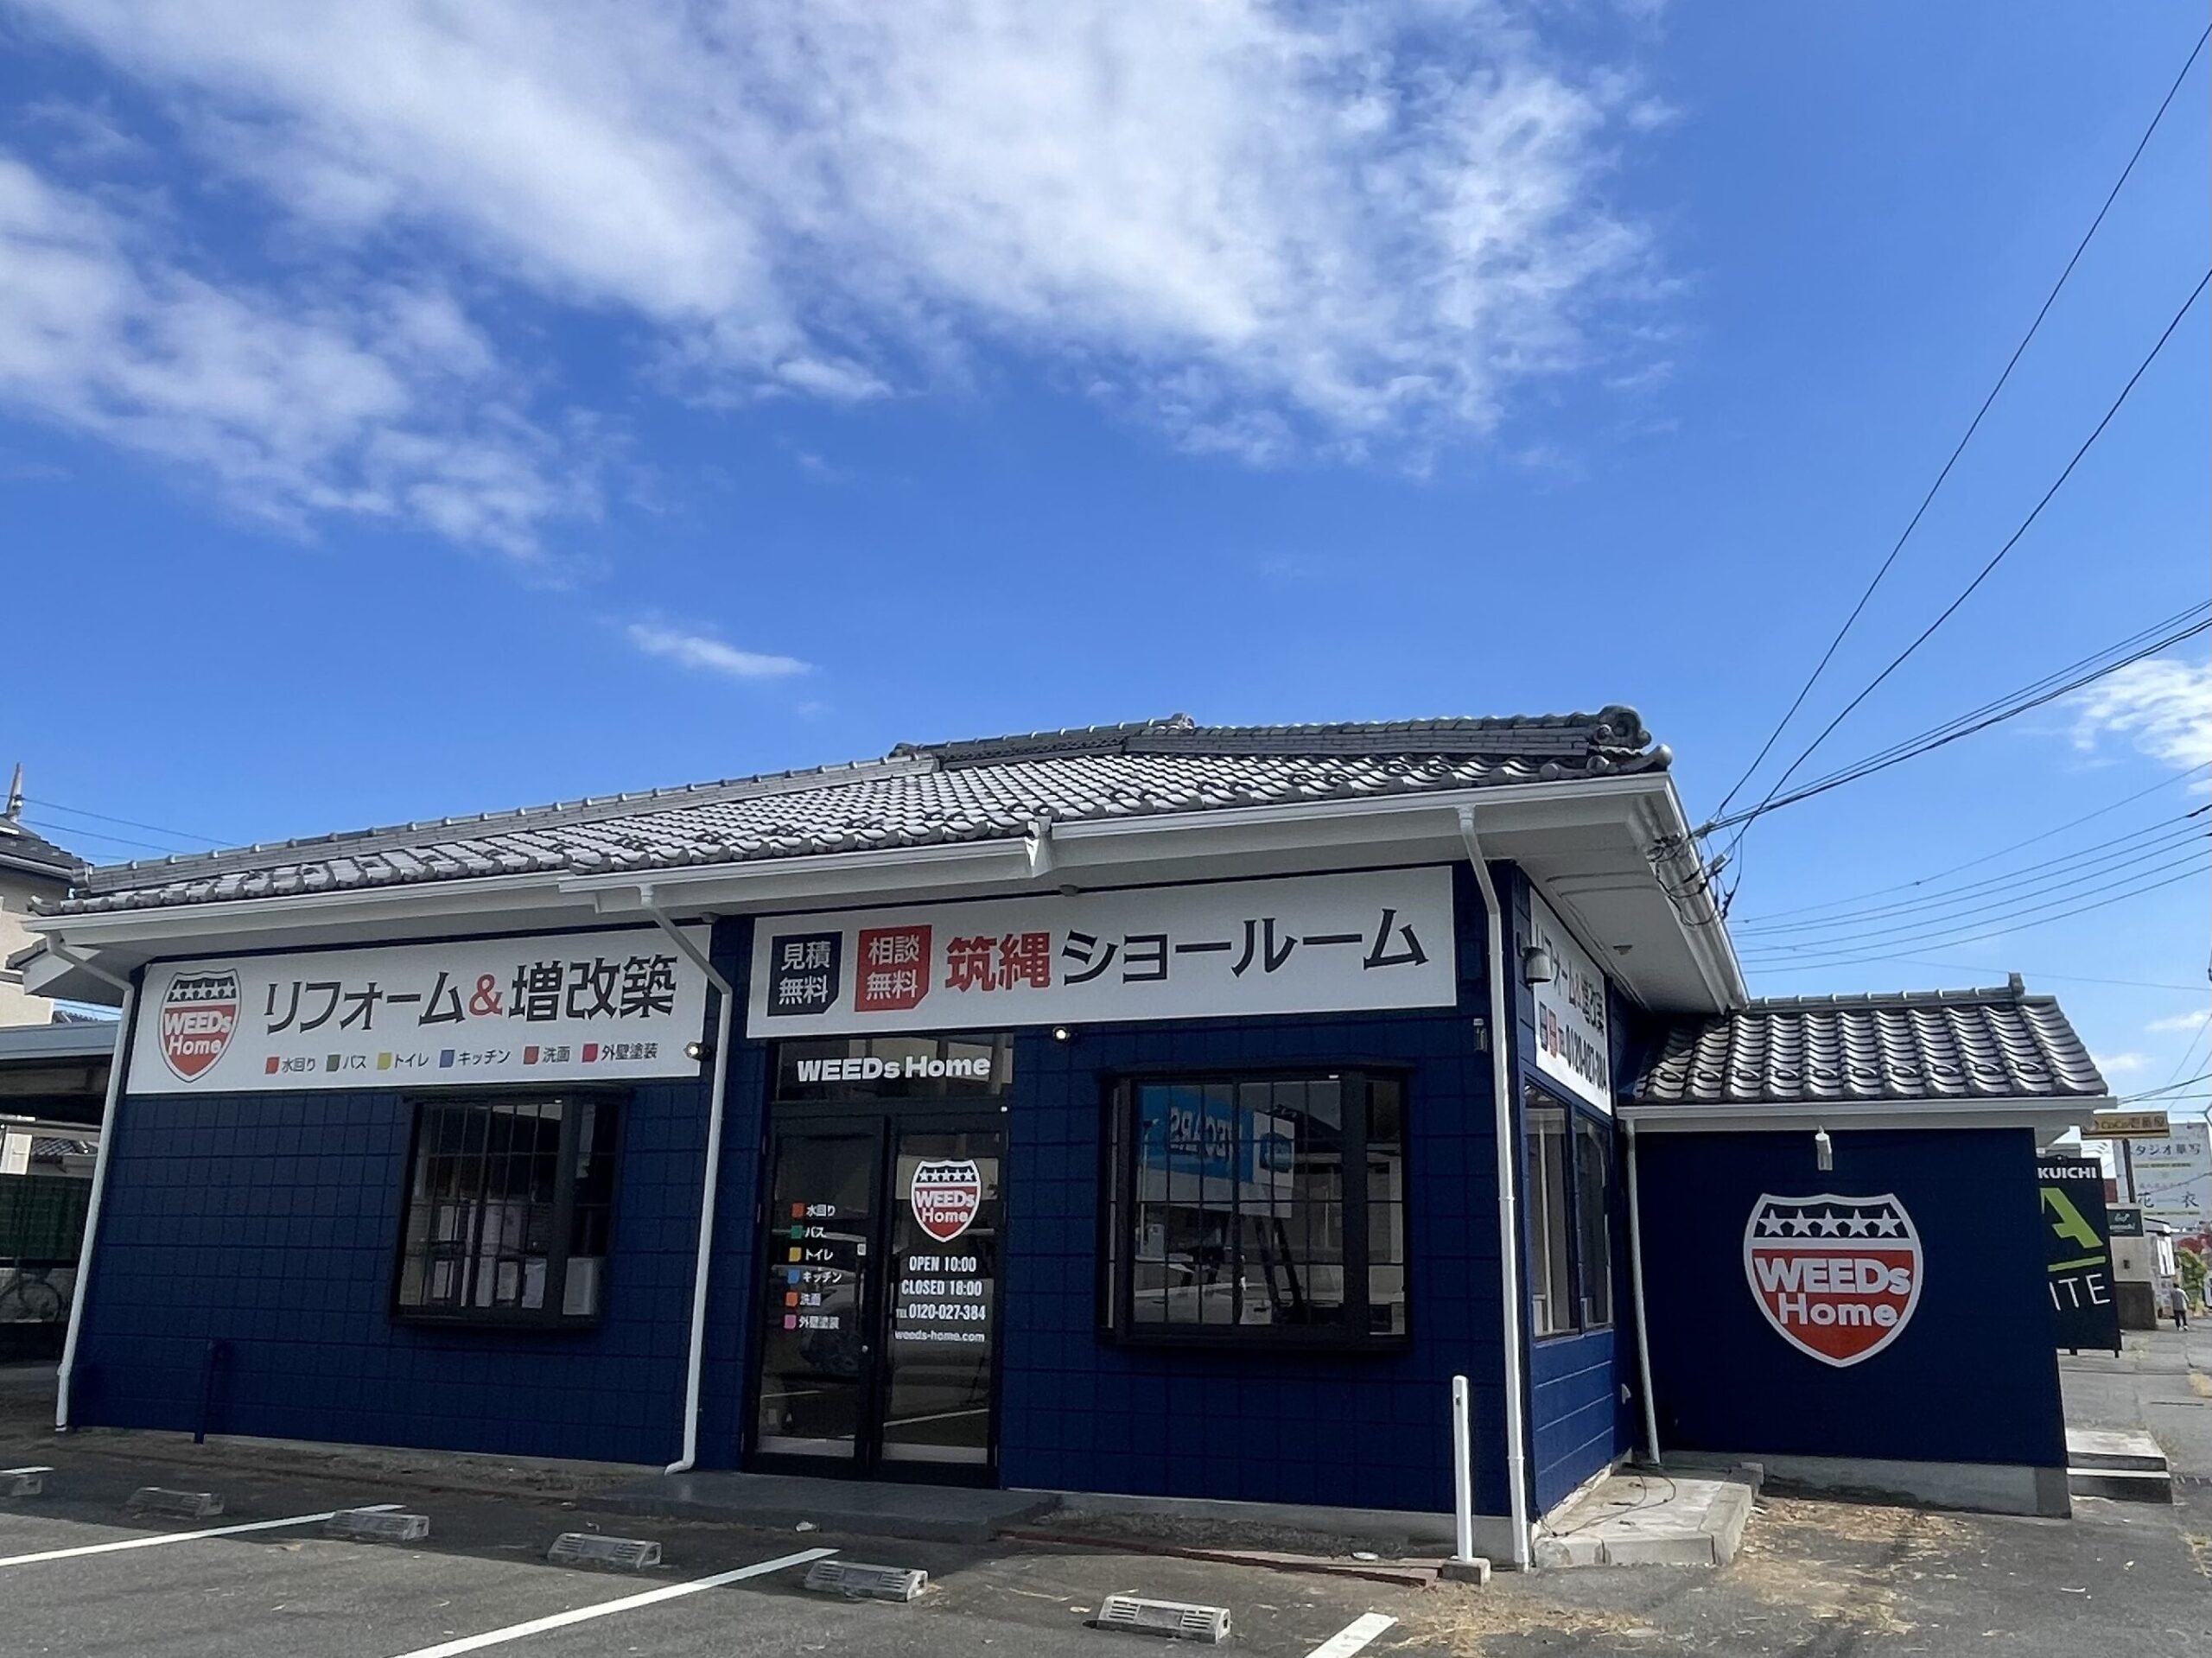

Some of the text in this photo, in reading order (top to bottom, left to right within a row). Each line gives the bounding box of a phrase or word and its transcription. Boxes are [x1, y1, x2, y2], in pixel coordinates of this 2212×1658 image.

[781, 941, 831, 972] 見積
[868, 935, 919, 966] 相談
[944, 907, 1430, 993] 筑縄ショールーム
[264, 954, 678, 1035] リフォーム&増改築
[779, 975, 829, 1005] 無料
[866, 969, 918, 1001] 無料
[164, 1010, 233, 1036] WEEDs
[168, 1035, 223, 1056] Home
[282, 1042, 658, 1073] 水回り バス トイレ キッチン 洗面 外壁塗装
[797, 1055, 992, 1083] WEEDs Home
[2037, 1166, 2098, 1179] KUICHI
[915, 1190, 976, 1208] WEEDs
[921, 1208, 969, 1223] Home
[804, 1226, 827, 1238] バス
[805, 1248, 834, 1261] トイレ
[909, 1255, 976, 1273] OPEN 10:00
[803, 1271, 842, 1283] キッチン
[901, 1280, 982, 1296] CLOSED 18:00
[1753, 1257, 1911, 1296] WEEDs
[909, 1303, 986, 1320] 0120-027-384
[1777, 1293, 1900, 1327] Home
[894, 1330, 985, 1343] weeds-home.com
